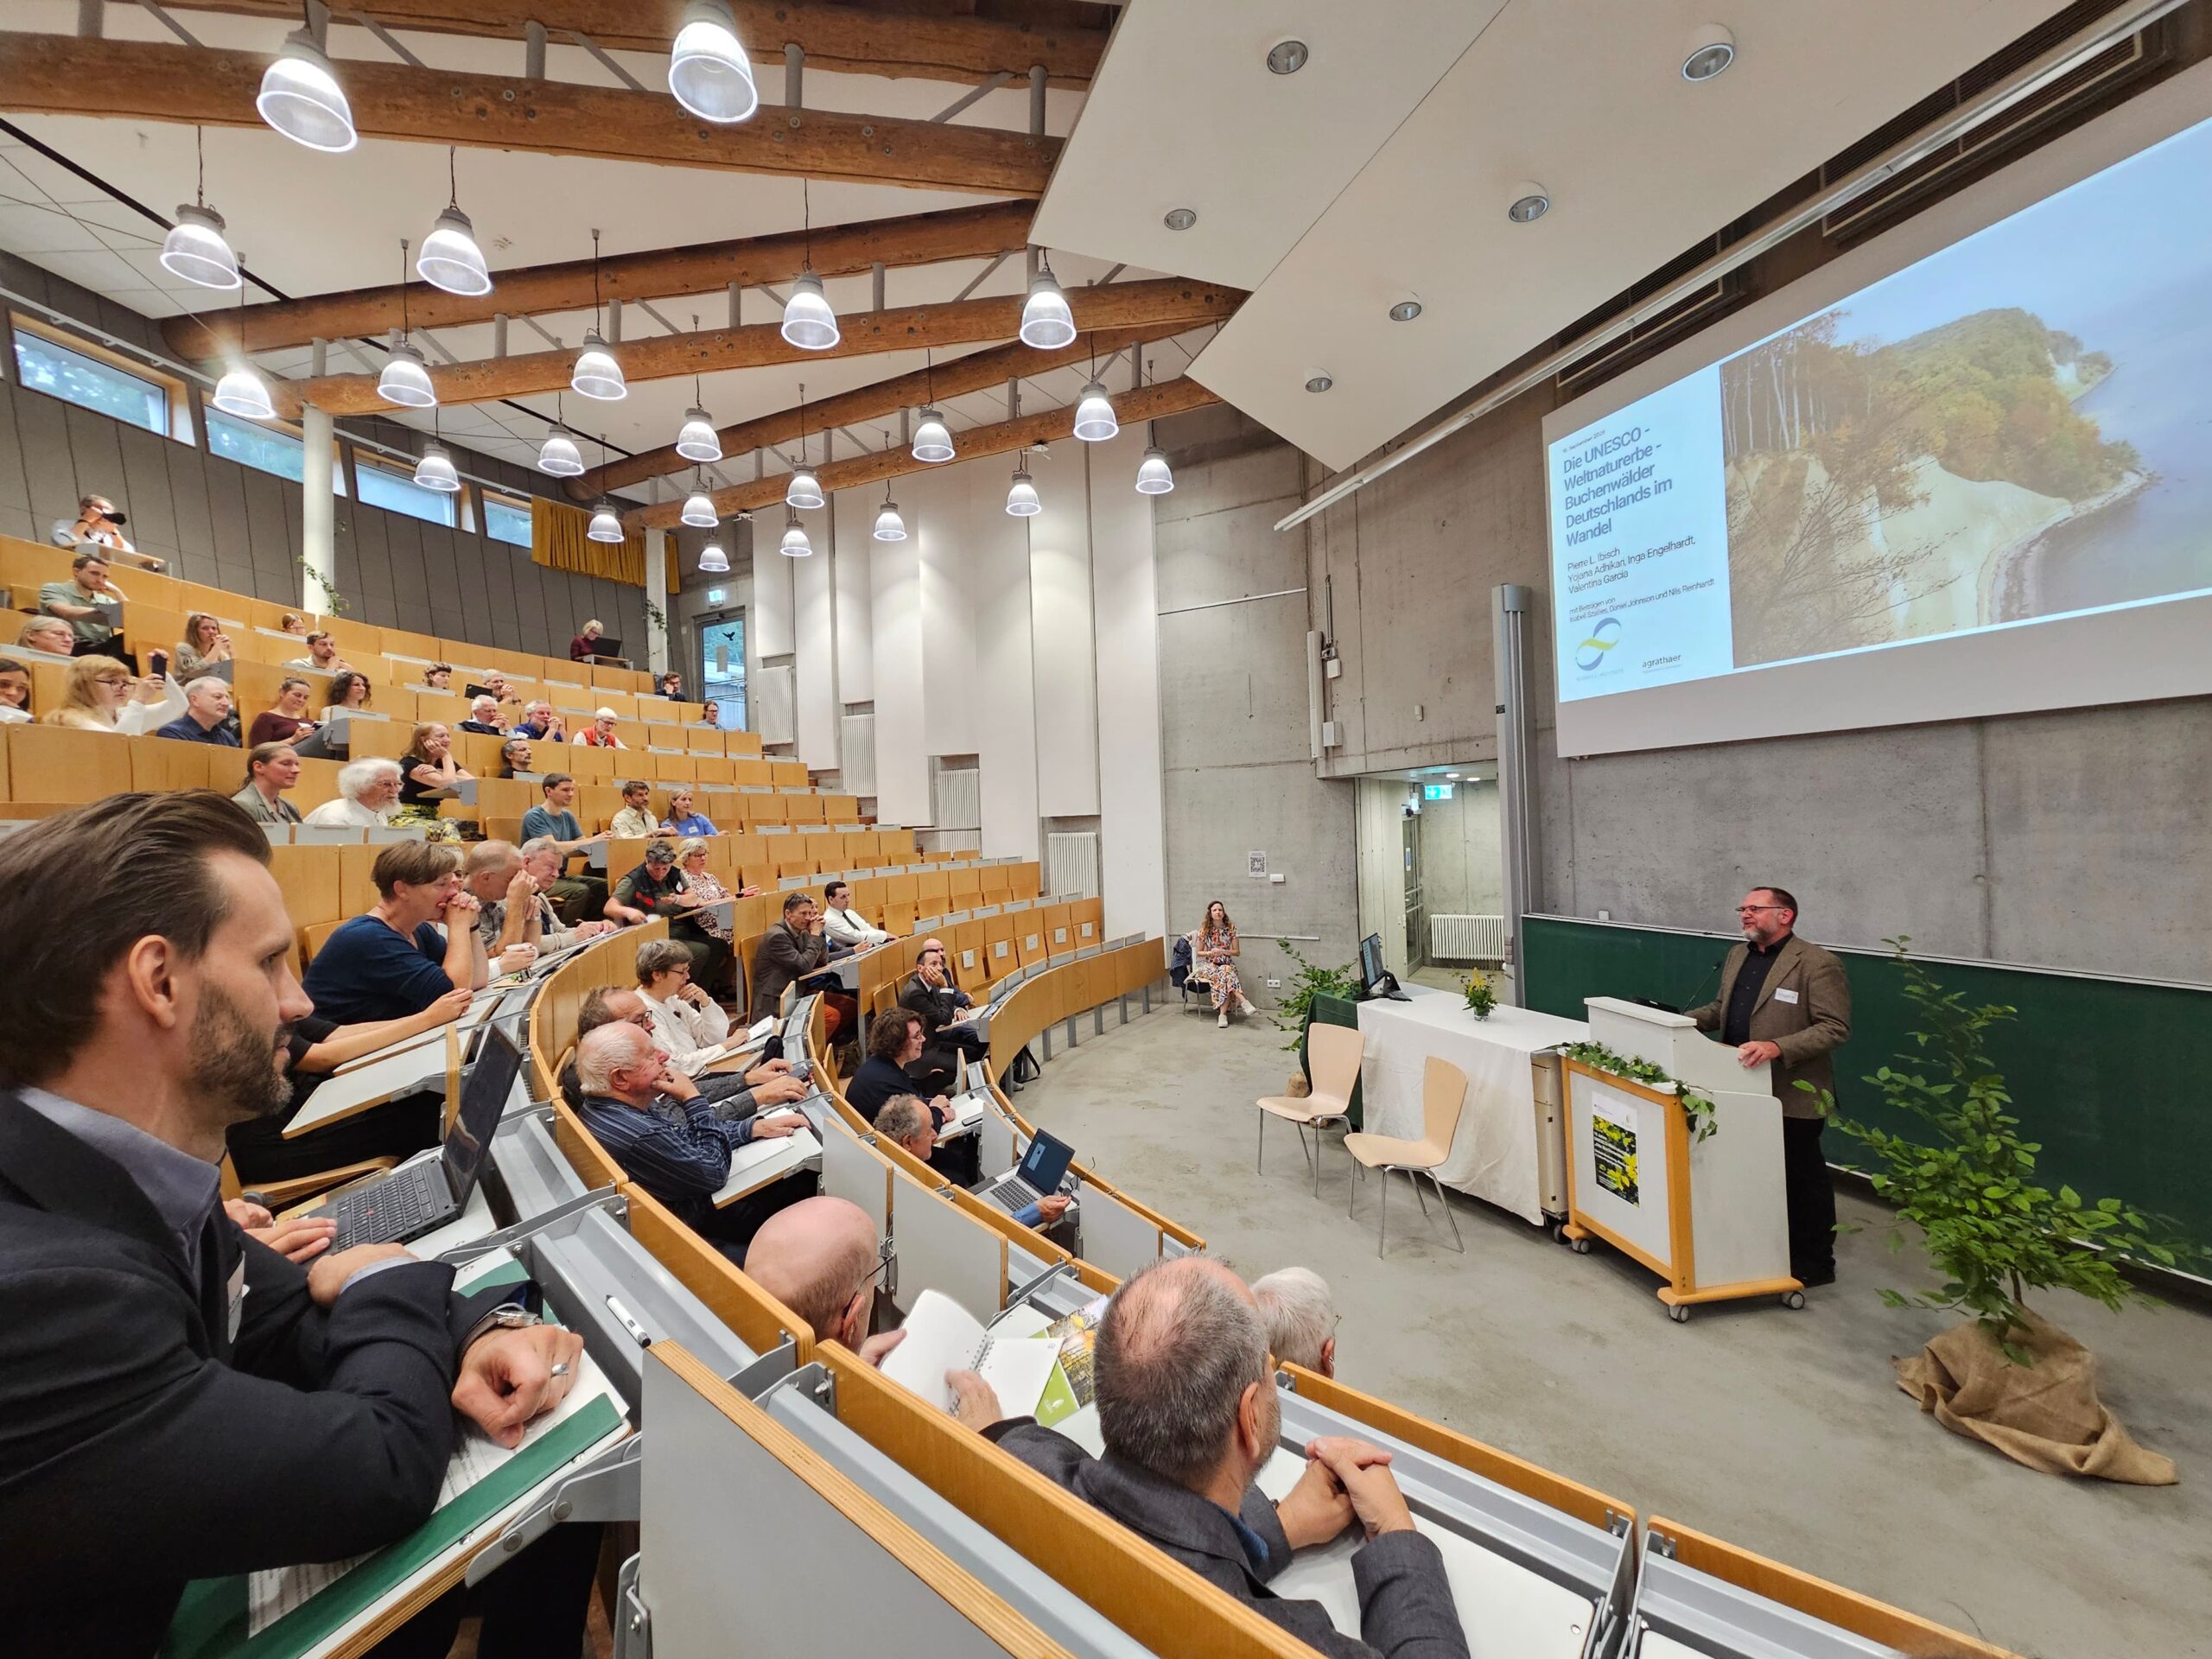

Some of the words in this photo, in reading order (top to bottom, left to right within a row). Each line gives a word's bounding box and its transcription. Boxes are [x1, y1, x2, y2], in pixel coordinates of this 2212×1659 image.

[1563, 456, 1582, 474] Die
[1585, 427, 1642, 463] UNESCO
[1564, 445, 1653, 492] Weltnaturerbe
[1565, 464, 1656, 511] Buchenwälder
[1566, 486, 1651, 529] Deutschlands
[1654, 478, 1673, 495] im
[1566, 518, 1612, 547] Wandel
[1567, 559, 1588, 571] Pierre
[1590, 556, 1596, 565] L.
[1598, 547, 1620, 562] Ibisch
[1567, 569, 1592, 583] Yojana
[1628, 553, 1645, 564] Inga
[1647, 535, 1696, 557] Engelhardt,
[1568, 579, 1602, 594] Valentina
[1627, 594, 1655, 607] Johnson
[1655, 590, 1669, 601] und
[1669, 587, 1681, 597] Nils
[1681, 578, 1714, 594] Reinhardt
[1642, 654, 1681, 669] agrathaer
